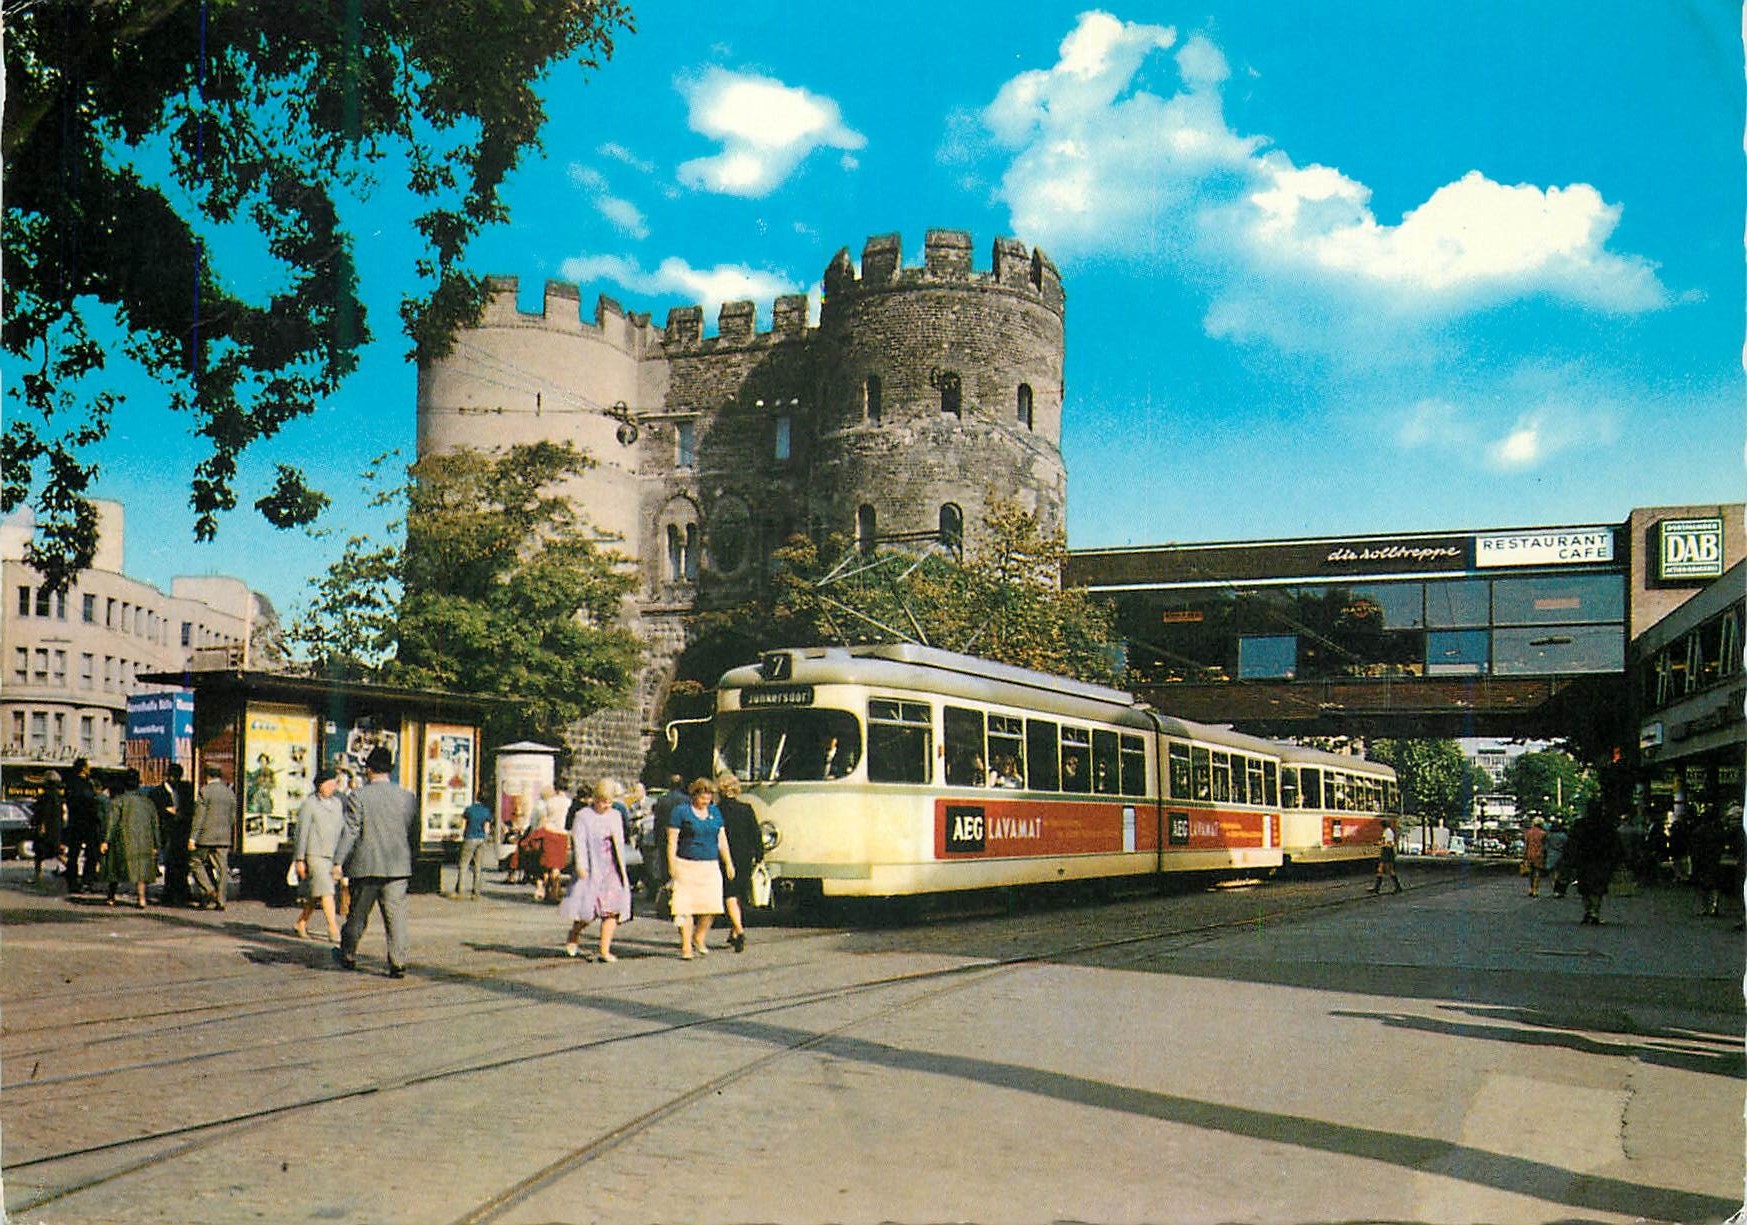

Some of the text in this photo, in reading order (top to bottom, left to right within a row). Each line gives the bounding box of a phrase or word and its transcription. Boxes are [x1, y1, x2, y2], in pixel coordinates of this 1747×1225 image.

[1483, 534, 1608, 550] RESTAURANT
[1667, 533, 1719, 562] DAB
[1327, 546, 1461, 561] die rolltreppe
[1559, 547, 1608, 559] CAFE
[773, 655, 784, 676] 7
[953, 815, 1043, 841] AEG LAVAMAT
